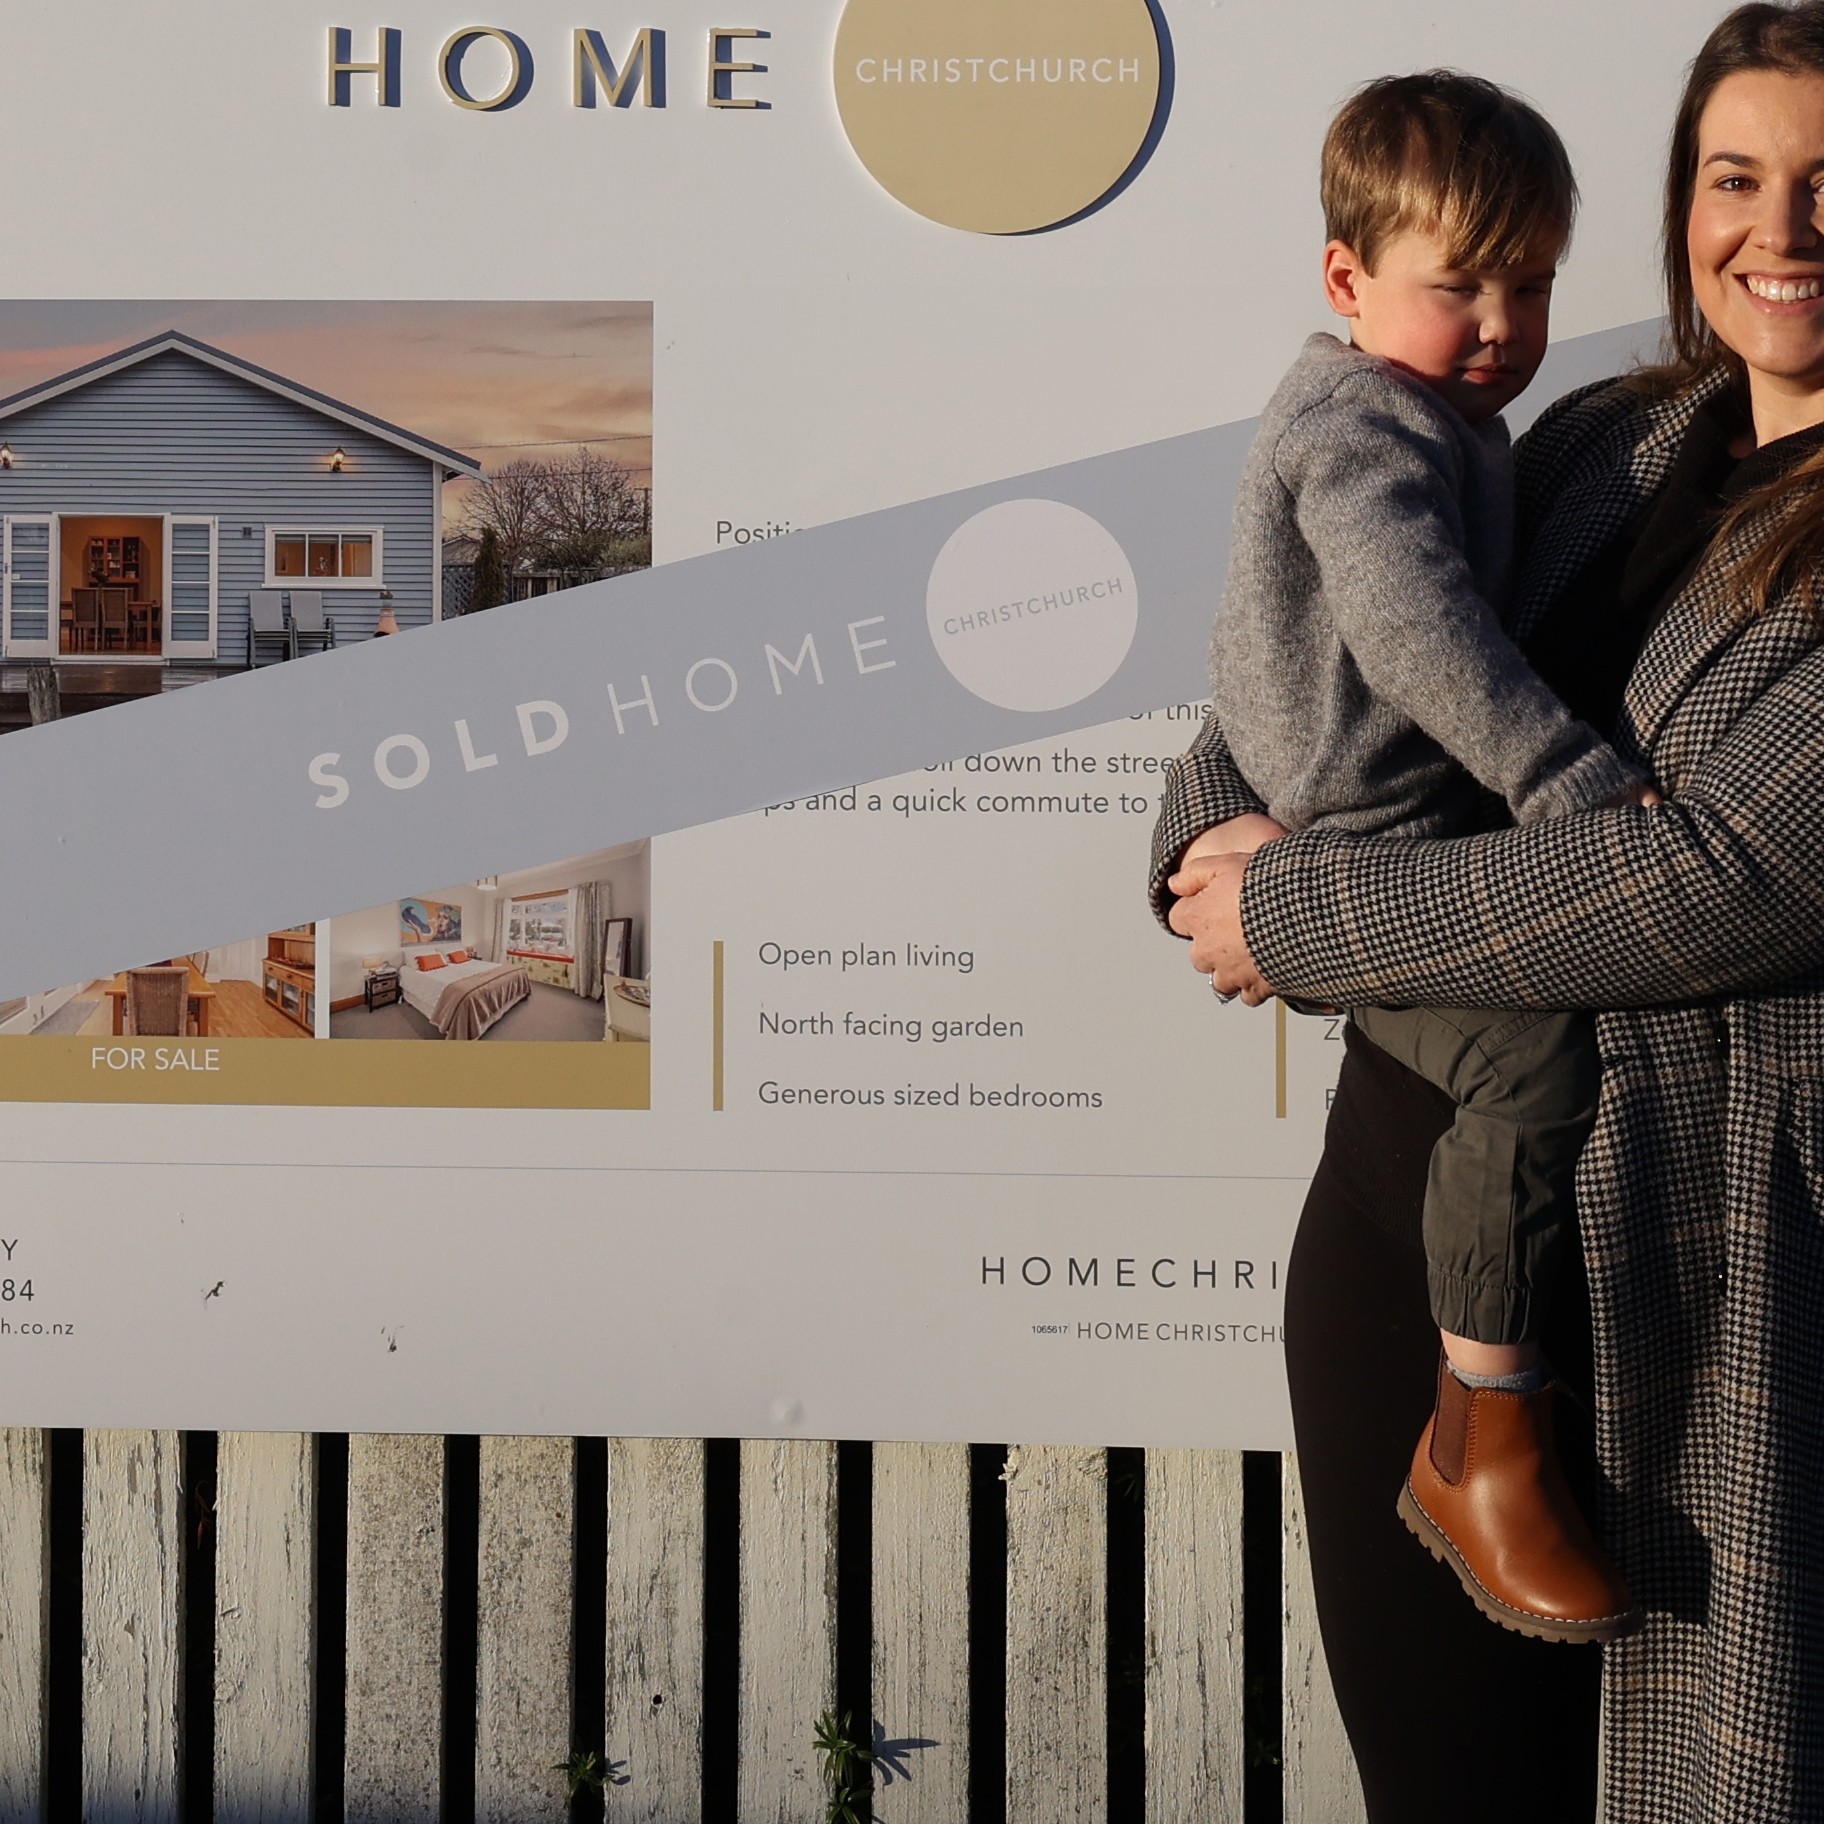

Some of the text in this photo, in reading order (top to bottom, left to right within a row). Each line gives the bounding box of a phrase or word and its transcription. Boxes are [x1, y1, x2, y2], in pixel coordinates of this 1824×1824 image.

[327, 26, 1140, 110] HOME CHRISTCHURCH
[716, 520, 804, 545] Positi
[308, 576, 1125, 809] SOLD HOME CHRISTCHURCH
[964, 753, 1041, 773] down
[1051, 747, 1097, 774] the
[1107, 752, 1176, 774] stree
[805, 785, 857, 811] and
[867, 794, 882, 812] a
[892, 786, 967, 818] quick
[976, 792, 1109, 814] commute
[1118, 793, 1148, 814] to
[758, 942, 975, 974] Open plan living
[759, 1011, 1024, 1043] North facing garden
[91, 1047, 220, 1071] FOR SALE
[758, 1081, 1103, 1108] Generous sized bedrooms
[981, 1256, 1278, 1290] HOMECHRI
[1077, 1322, 1149, 1340] HOME
